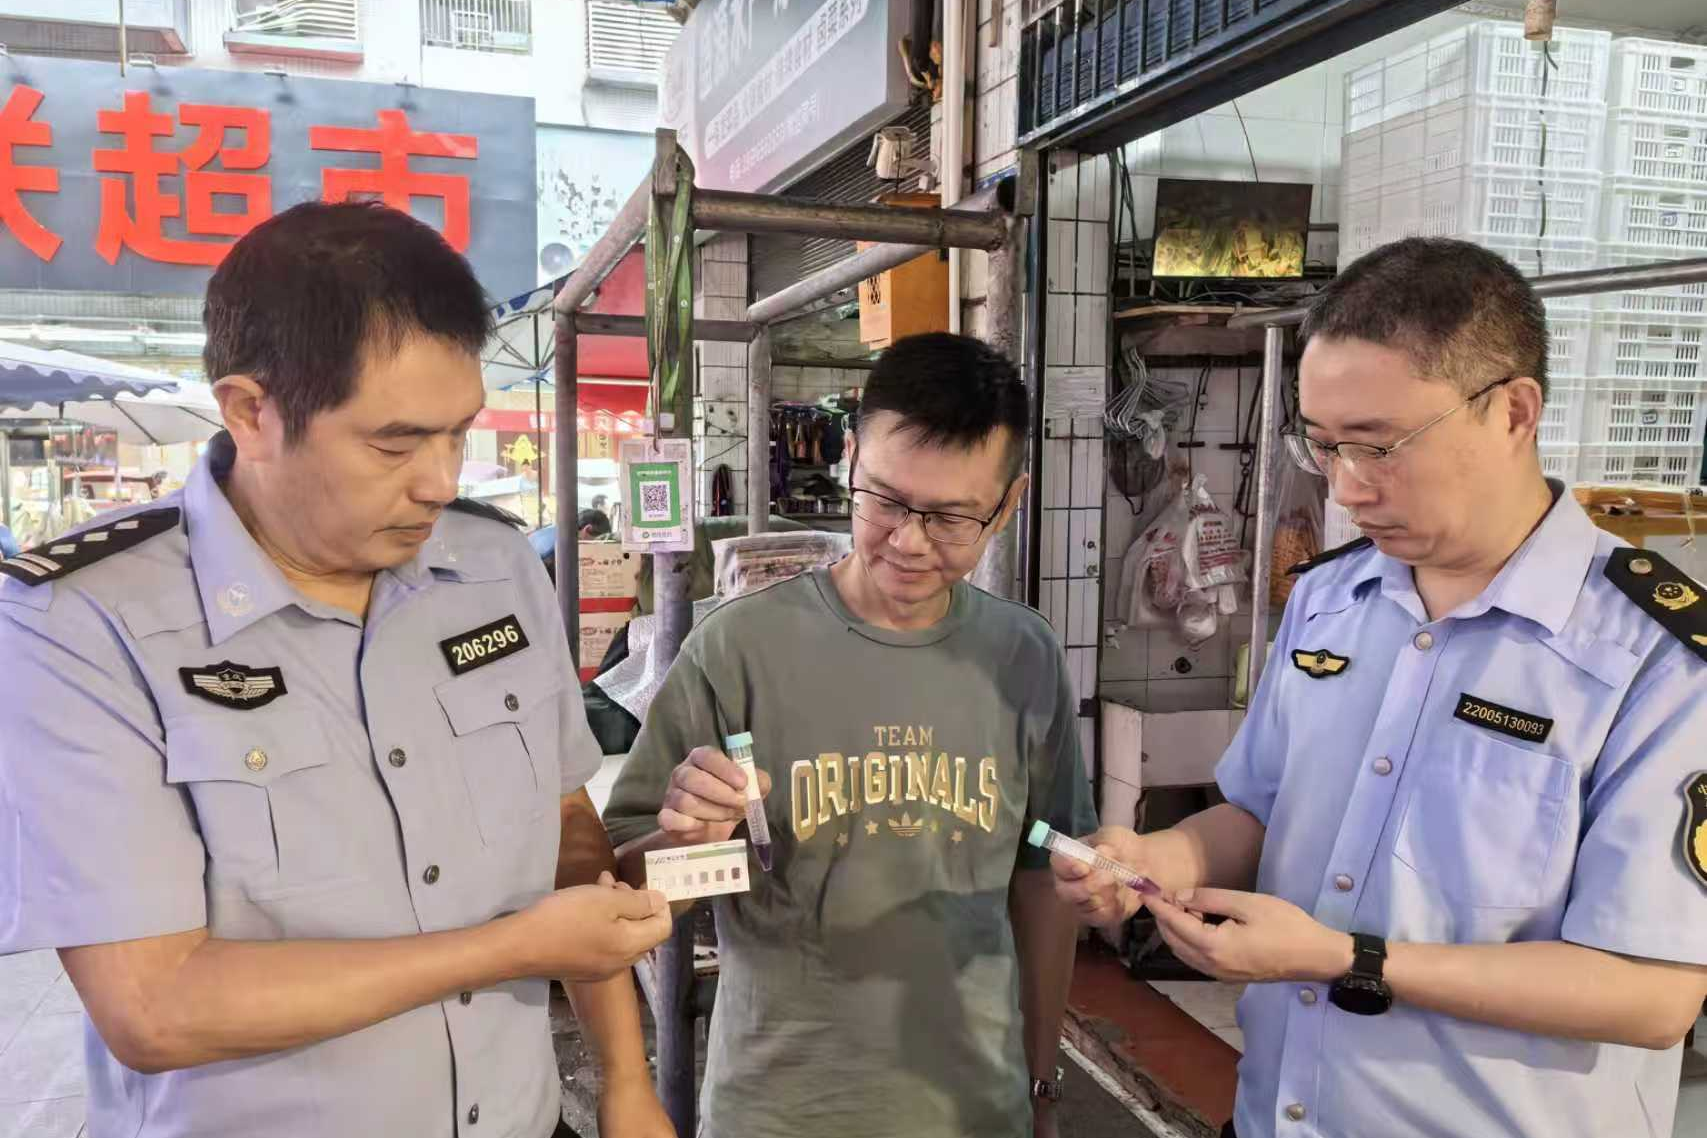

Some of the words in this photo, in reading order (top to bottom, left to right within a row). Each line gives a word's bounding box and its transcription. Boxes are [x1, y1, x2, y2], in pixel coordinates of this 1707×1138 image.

[452, 624, 519, 665] 206296
[873, 725, 933, 747] TEAM
[1462, 701, 1545, 735] 22005130093
[790, 751, 999, 842] ORIGINALS
